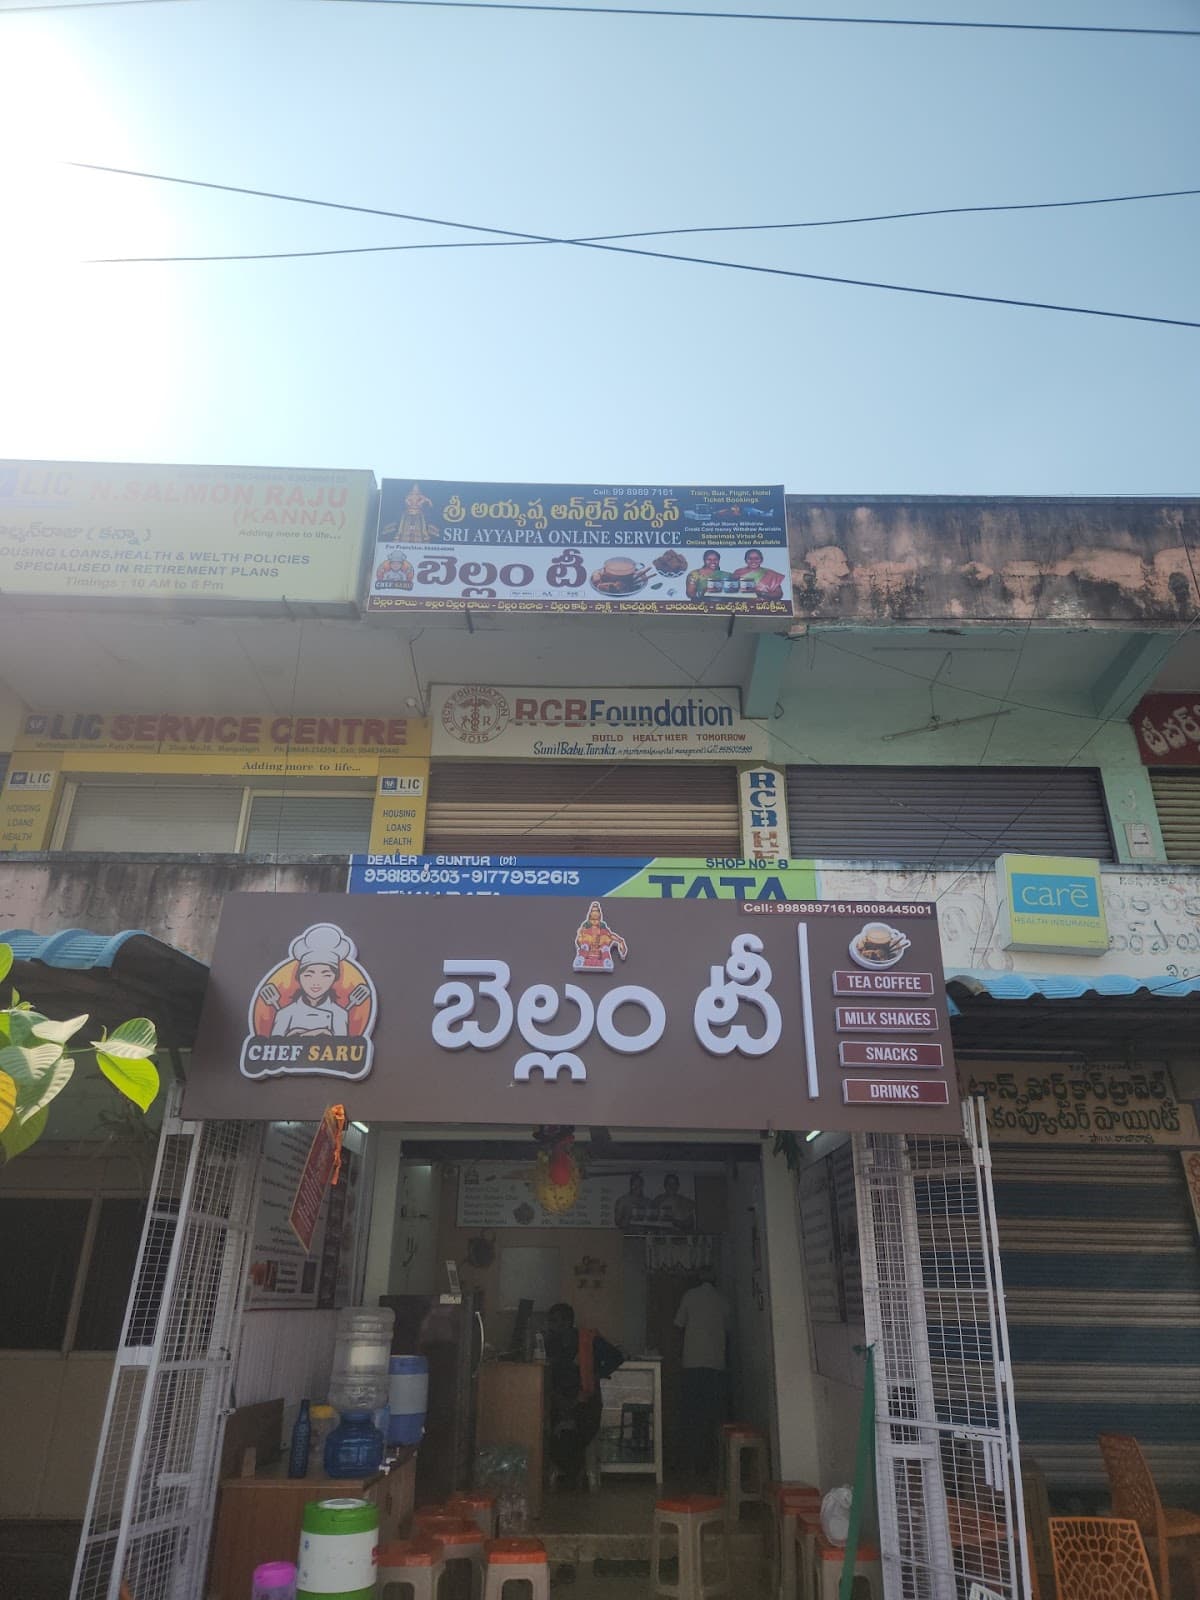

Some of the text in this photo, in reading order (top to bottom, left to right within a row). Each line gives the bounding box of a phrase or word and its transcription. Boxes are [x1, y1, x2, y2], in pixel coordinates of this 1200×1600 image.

[264, 485, 350, 509] RAJU
[443, 495, 467, 522] శ్రీ
[443, 528, 682, 546] SRI AYYAPPA ONLINE SERVICE
[189, 551, 240, 563] WELTH
[243, 553, 311, 565] POLICIES
[14, 560, 280, 577] SPECIALISED IN RETIREMENT PLANS
[417, 548, 588, 598] బెల్లం టీ
[50, 713, 408, 746] LIC SERVICE CENTRE
[592, 734, 624, 744] BUILD
[697, 735, 746, 744] TOMORROW
[242, 761, 286, 774] Adding
[287, 763, 314, 771] more
[319, 762, 330, 771] to
[29, 772, 51, 784] LIC
[400, 779, 421, 790] LIC
[383, 809, 416, 819] HOUSING
[386, 823, 412, 833] LOANS
[383, 837, 412, 847] HEALTH
[367, 855, 418, 866] DEALER
[436, 856, 491, 867] GUNTUR
[706, 858, 746, 871] SHOP
[743, 903, 773, 913] Cell:
[847, 975, 922, 992] TEA COFFEE
[432, 932, 783, 1083] బెల్లం టీ
[845, 1011, 931, 1027] MILK SHAKES
[248, 1045, 365, 1062] CHEF SARU
[866, 1047, 919, 1062] SNACKS
[870, 1082, 920, 1098] DRINKS
